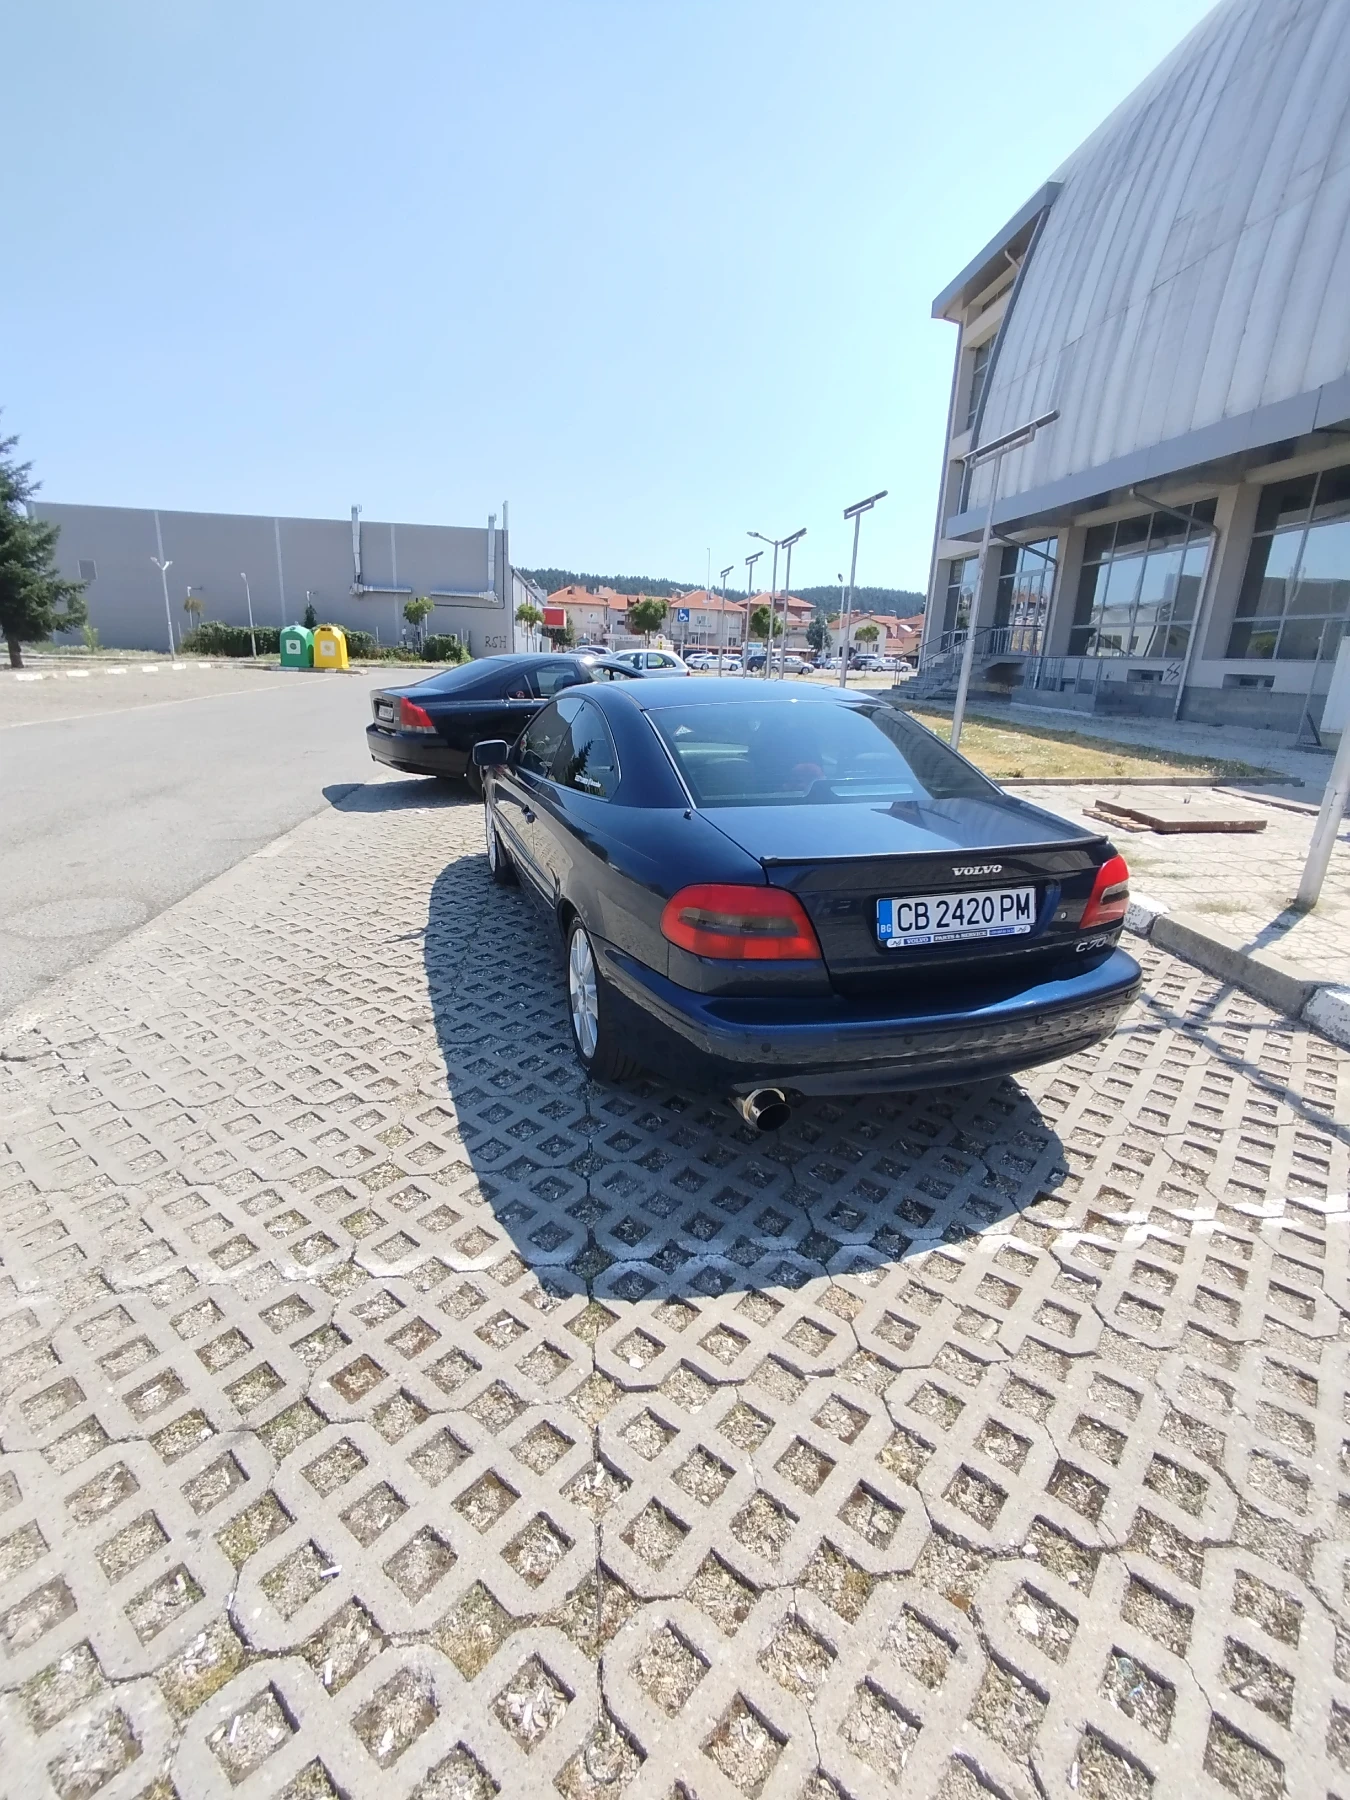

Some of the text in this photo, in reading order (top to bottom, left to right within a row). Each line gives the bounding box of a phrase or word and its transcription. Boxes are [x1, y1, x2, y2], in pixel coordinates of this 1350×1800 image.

[951, 864, 1003, 876] VOLVO
[897, 892, 1030, 932] CB 2420 PM
[880, 924, 892, 933] BG
[1076, 936, 1107, 952] C70
